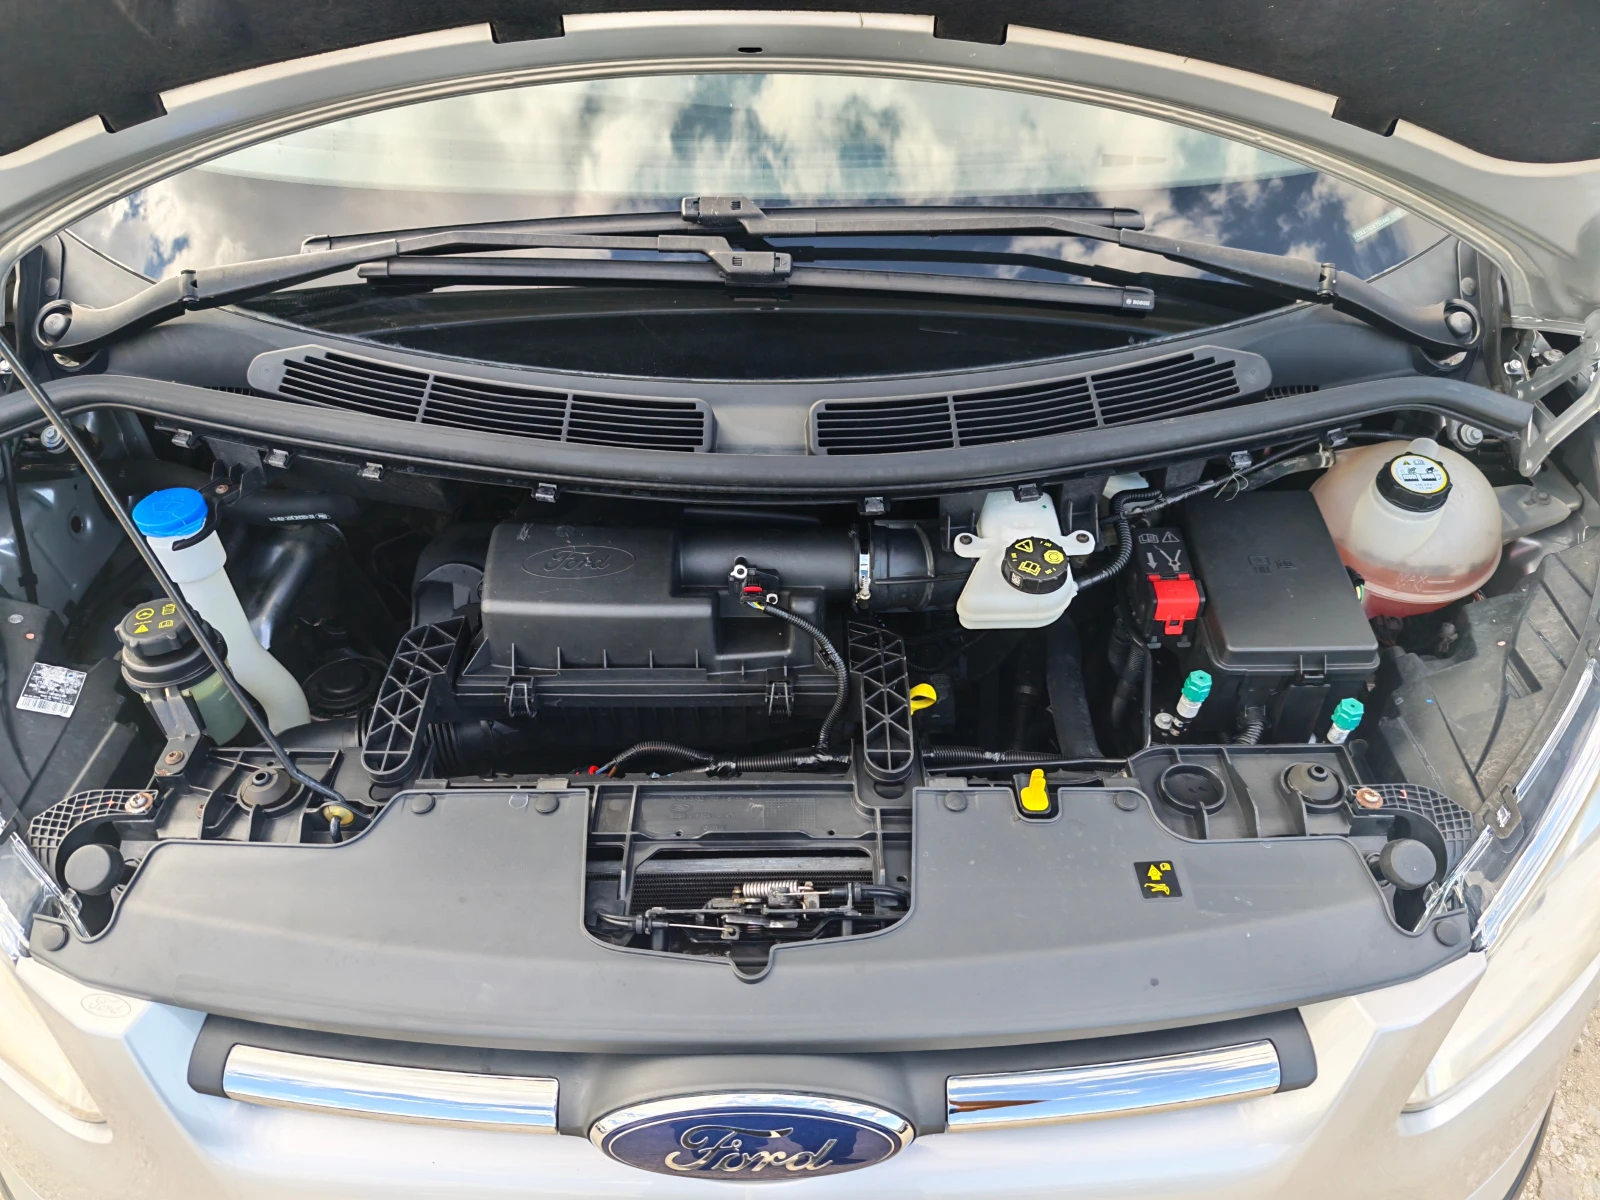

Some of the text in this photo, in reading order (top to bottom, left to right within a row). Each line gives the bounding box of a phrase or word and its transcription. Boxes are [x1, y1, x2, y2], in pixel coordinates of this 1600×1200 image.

[543, 550, 611, 572] Ford
[1396, 572, 1428, 585] MAX
[88, 996, 124, 1015] Ford
[663, 1124, 838, 1172] Ford
